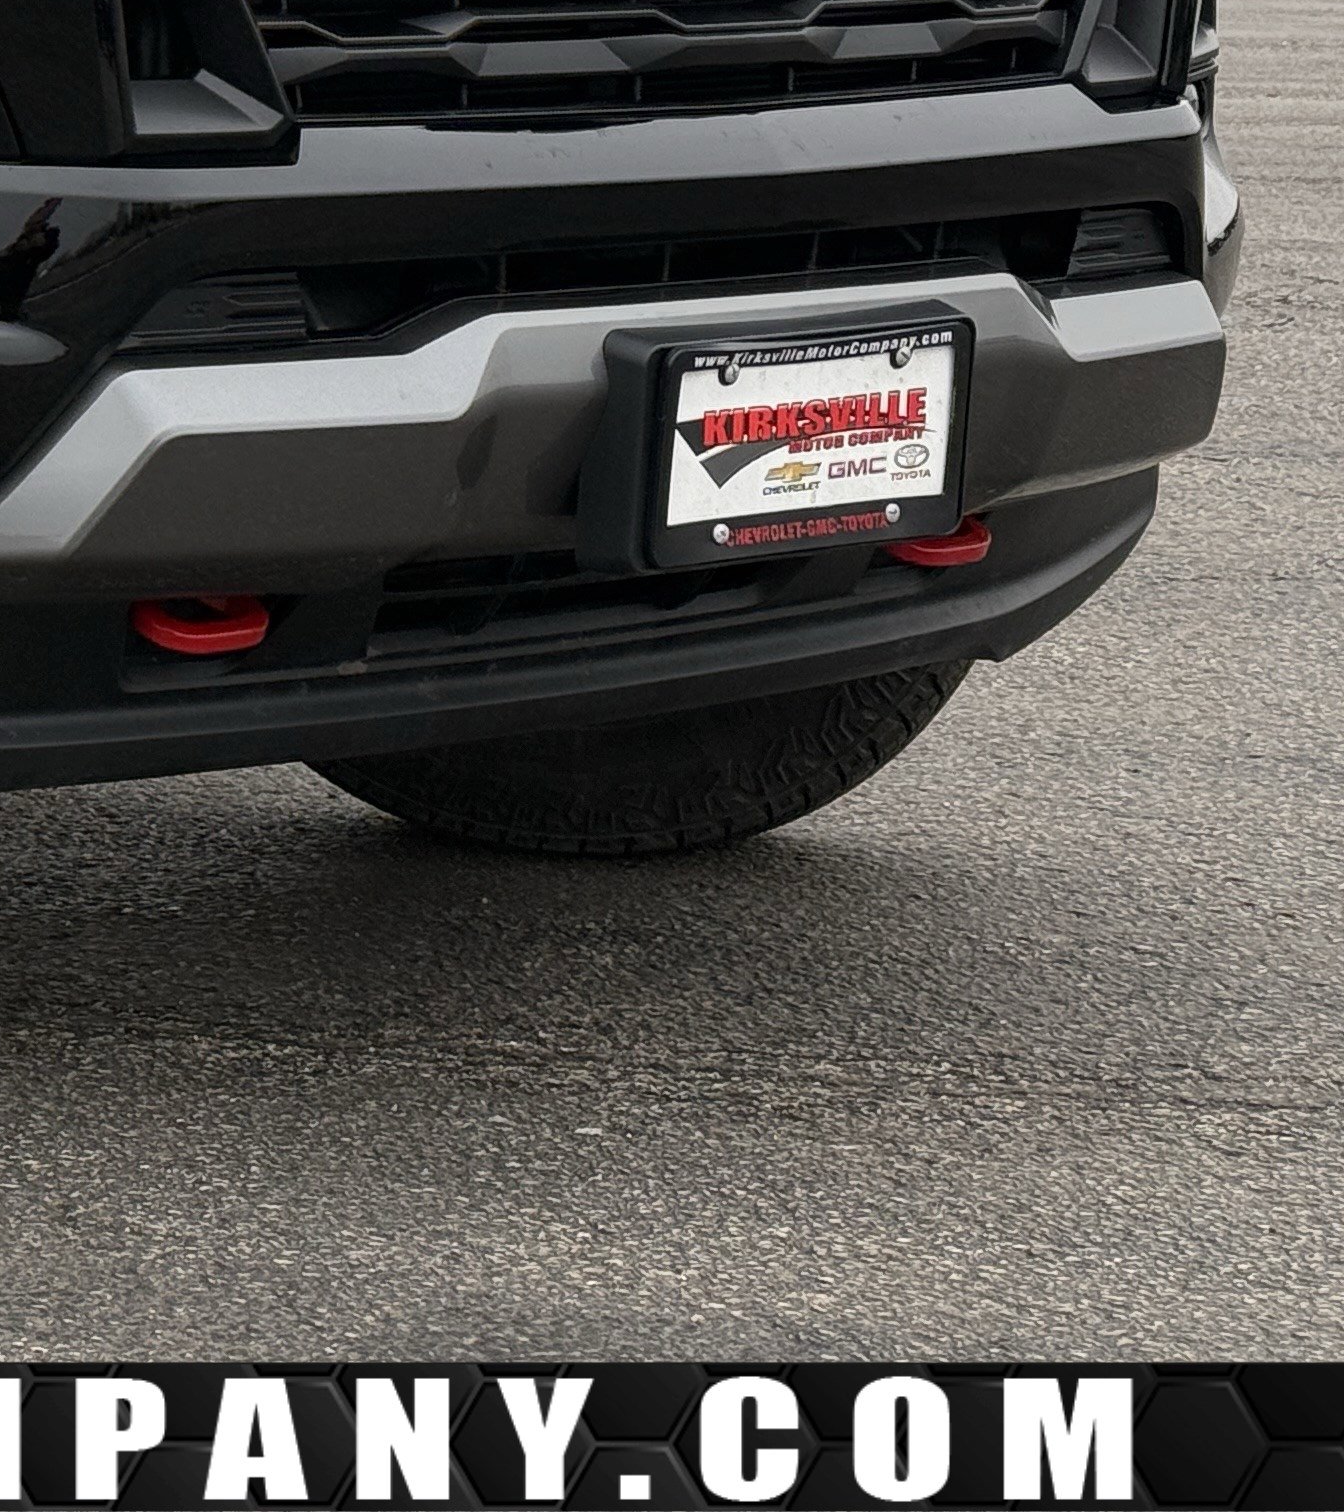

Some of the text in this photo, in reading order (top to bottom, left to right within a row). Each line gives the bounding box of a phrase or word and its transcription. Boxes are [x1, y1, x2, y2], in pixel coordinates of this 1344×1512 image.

[702, 386, 928, 447] KIRKSVILLE
[788, 425, 926, 454] MOTOR COMPANY
[827, 456, 888, 480] GMC
[890, 468, 932, 482] TOYOTA
[762, 480, 821, 496] CHEVROLET
